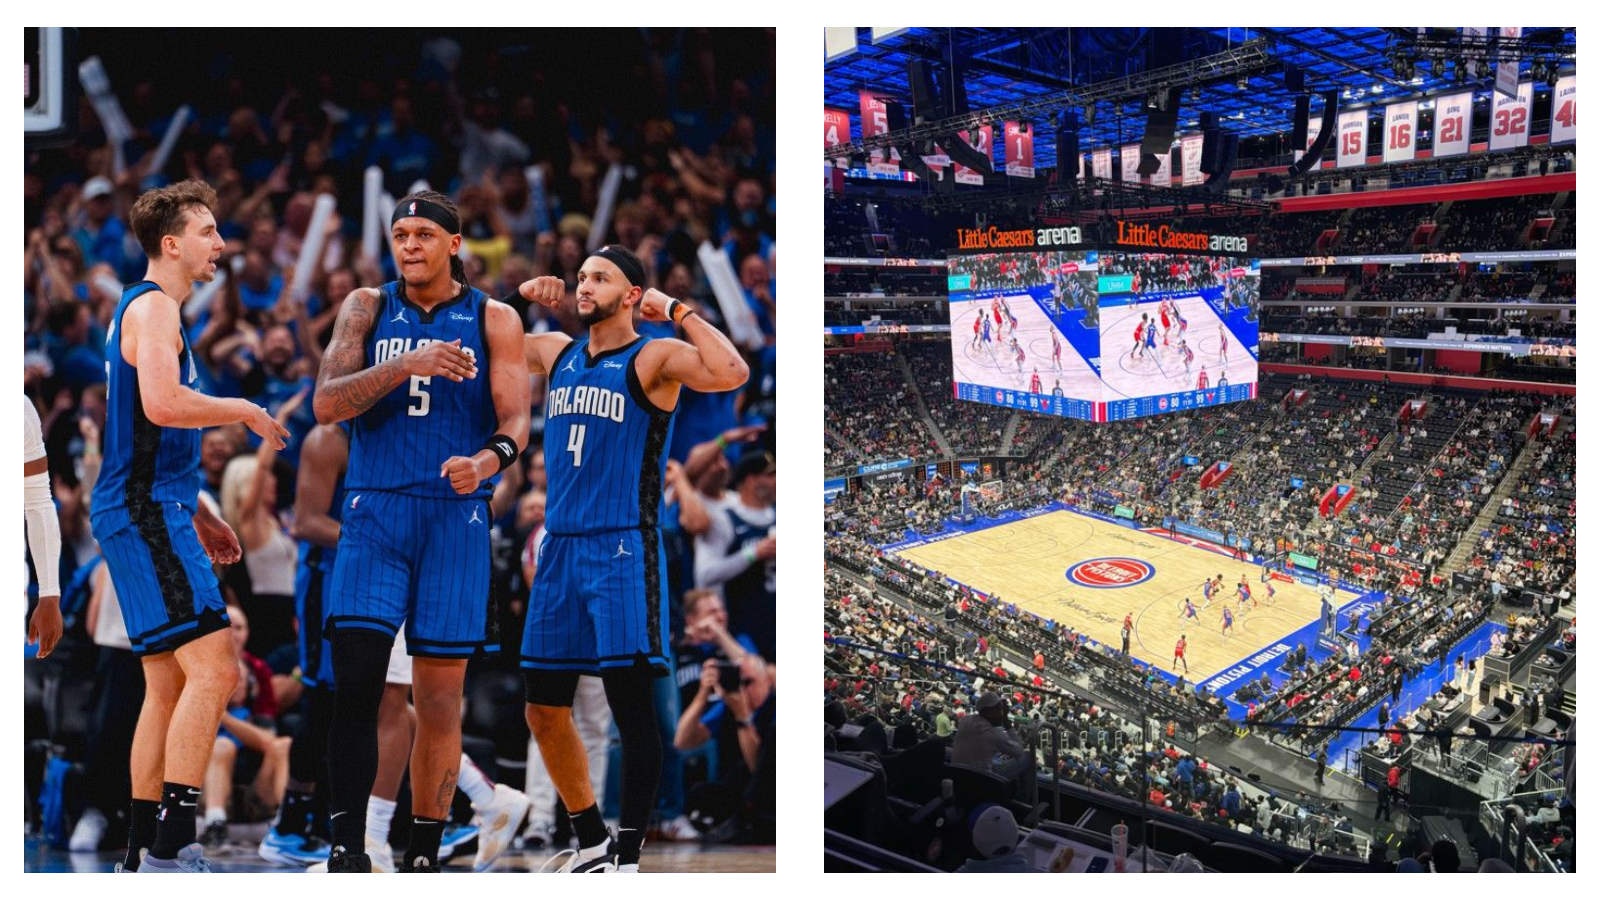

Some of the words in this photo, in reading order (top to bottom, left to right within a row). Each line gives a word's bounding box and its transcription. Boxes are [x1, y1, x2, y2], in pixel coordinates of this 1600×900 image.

[1494, 107, 1527, 136] 32
[1554, 100, 1576, 128] 4
[826, 125, 840, 147] 4
[1389, 123, 1411, 150] 16
[1440, 116, 1463, 144] 21
[1016, 137, 1024, 160] 1
[1342, 131, 1362, 157] 15
[957, 228, 988, 249] Little
[988, 226, 1034, 249] Caesars
[1037, 225, 1082, 245] arena
[1117, 220, 1157, 247] Little
[1157, 225, 1209, 251] Caesars
[1209, 233, 1248, 252] arena
[450, 311, 474, 323] Disney
[603, 360, 623, 370] Disney
[407, 375, 431, 417] 5
[549, 385, 625, 424] ORLANDO
[1170, 397, 1180, 408] 80
[566, 424, 586, 467] 4
[1084, 565, 1126, 582] PISTONS
[1097, 562, 1138, 578] DETROIT
[1247, 643, 1293, 668] DETROIT
[1206, 665, 1254, 693] PISTONS
